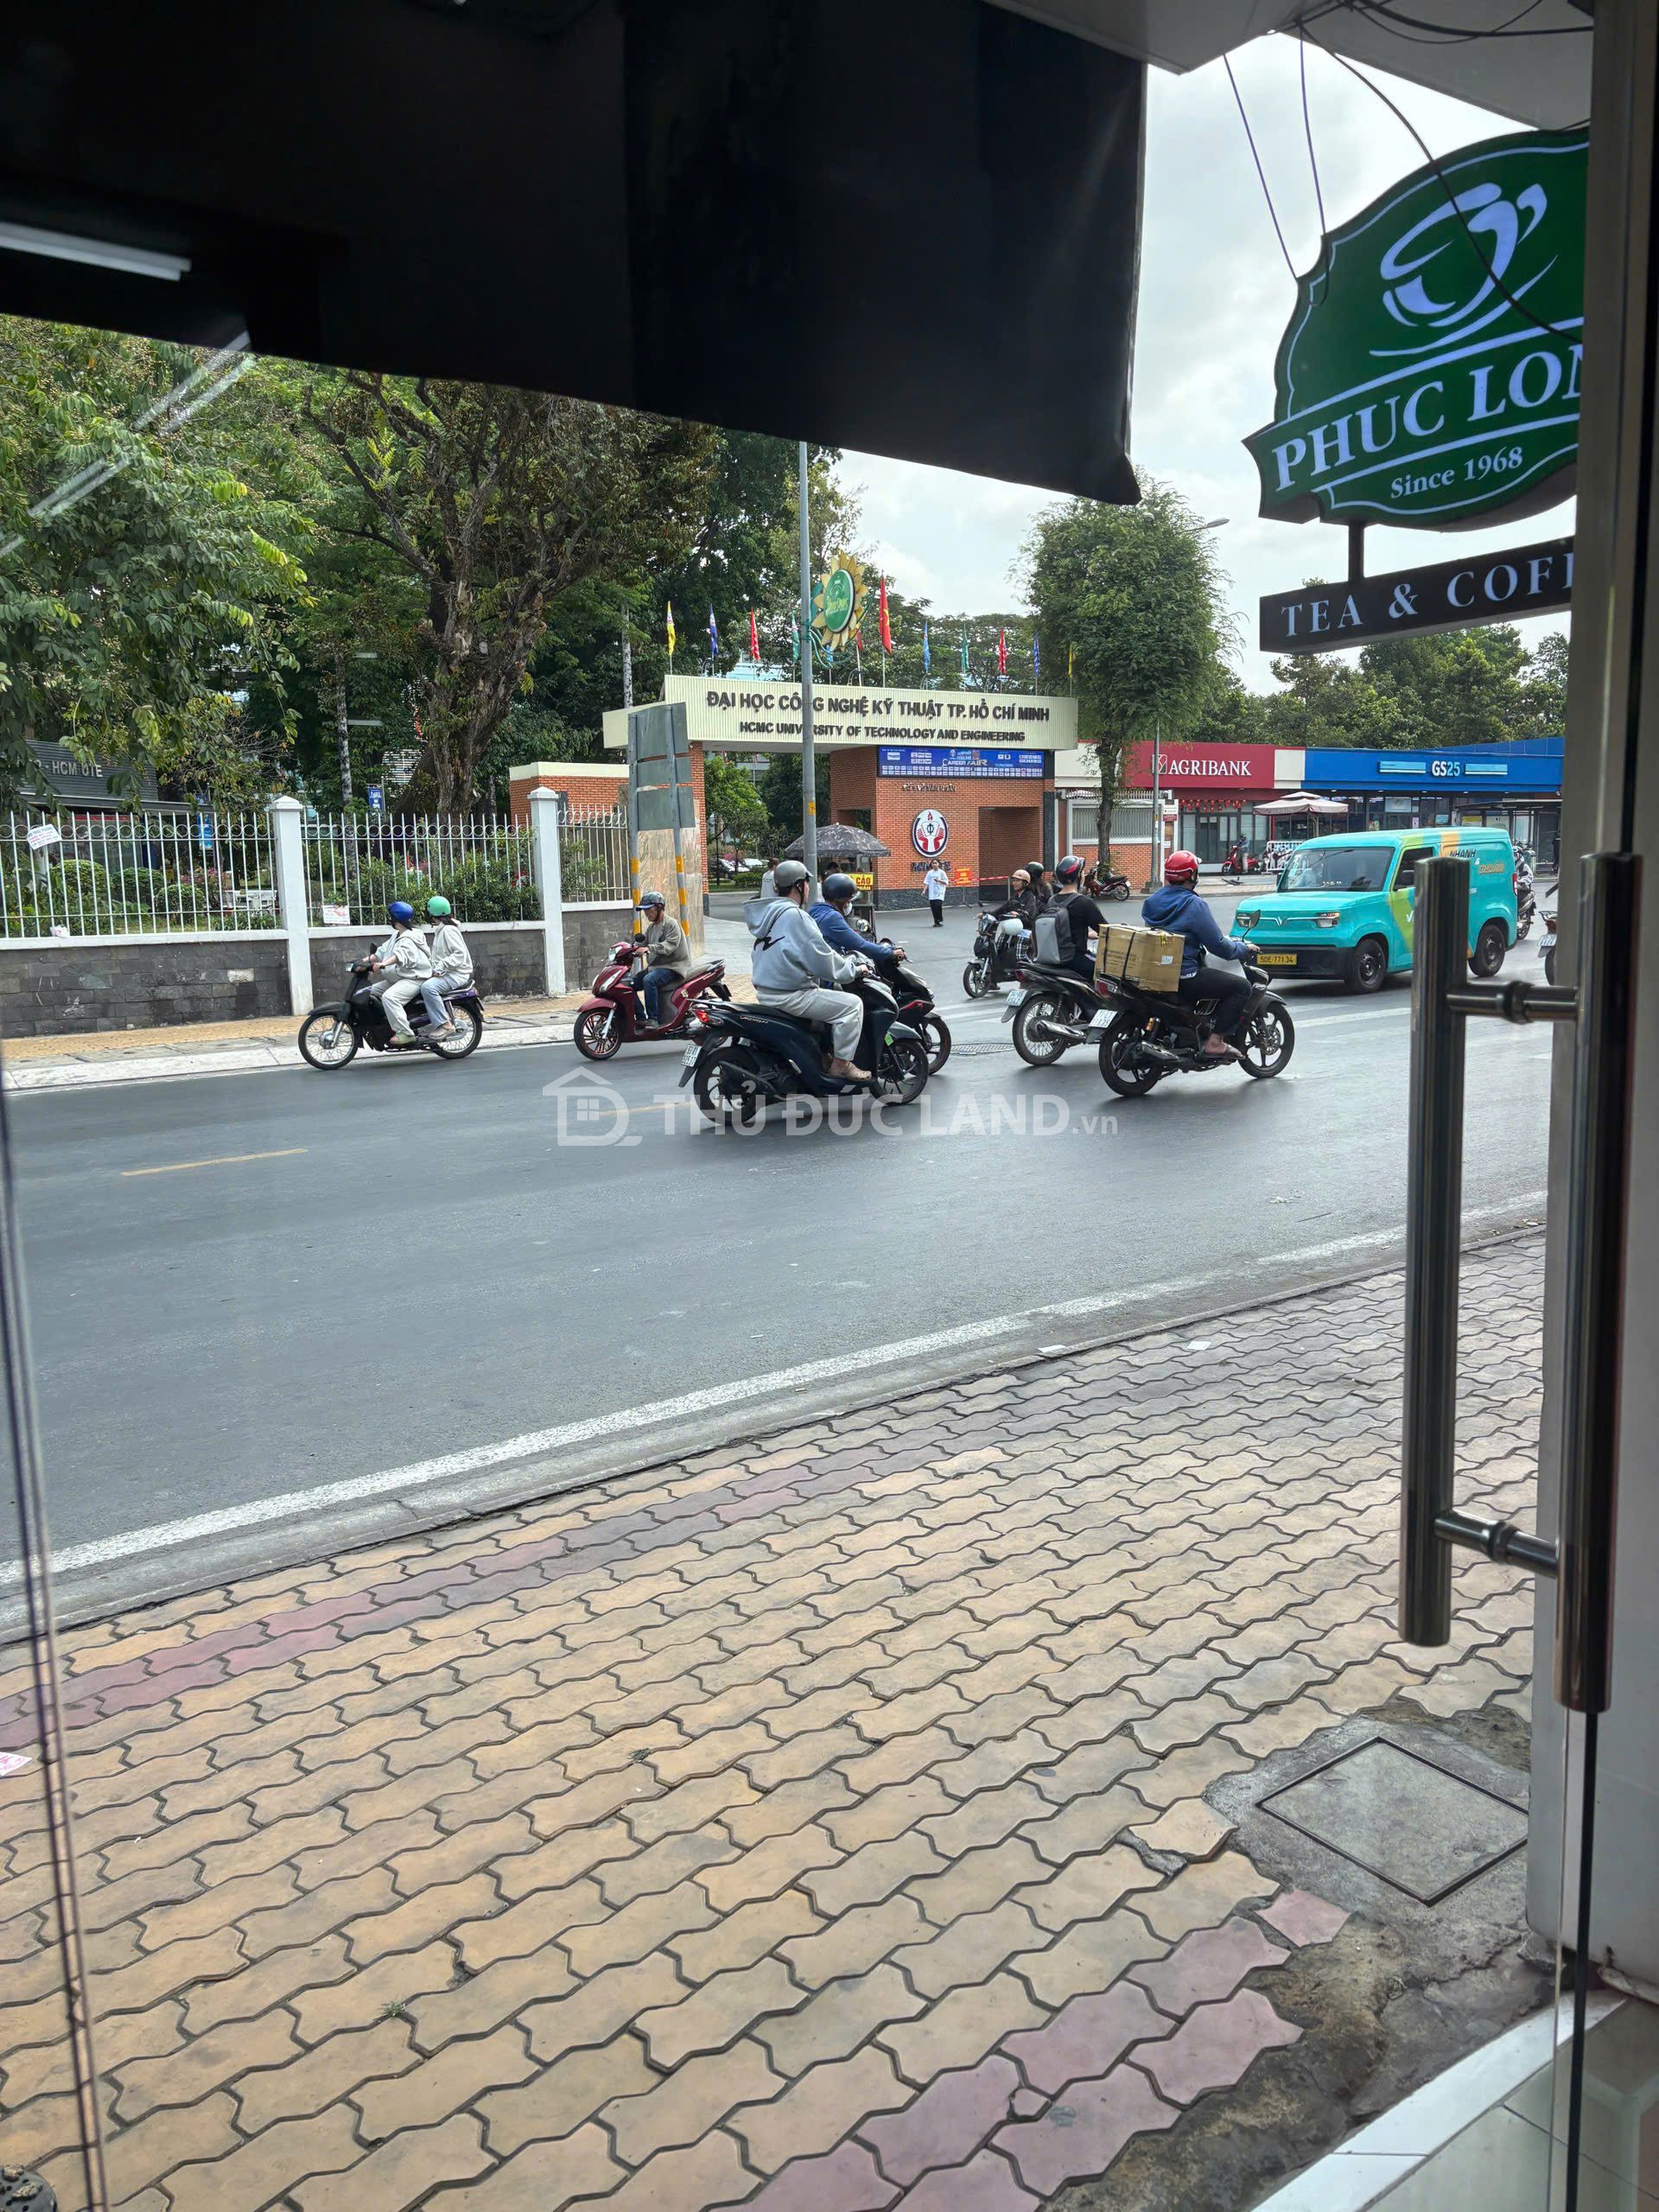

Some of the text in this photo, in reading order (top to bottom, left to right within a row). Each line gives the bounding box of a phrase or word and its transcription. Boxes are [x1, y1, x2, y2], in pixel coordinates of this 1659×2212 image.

[1272, 381, 1445, 492] PHUC
[1390, 447, 1523, 499] Since 1968
[1281, 594, 1363, 637] TEA
[1389, 583, 1419, 620] &
[707, 690, 1050, 721] ĐẠI HỌC CÔG NGHỆ KỸ THUẬT TP. HỒ CHÍ MINH
[740, 721, 1026, 741] HCMC UNIVRSITY OF TECHNOLOGY AND ENGINEERING
[52, 760, 77, 776] HCM
[1168, 760, 1252, 776] AGRIBANK
[1432, 760, 1460, 777] GS25
[1449, 849, 1477, 858] NHANH
